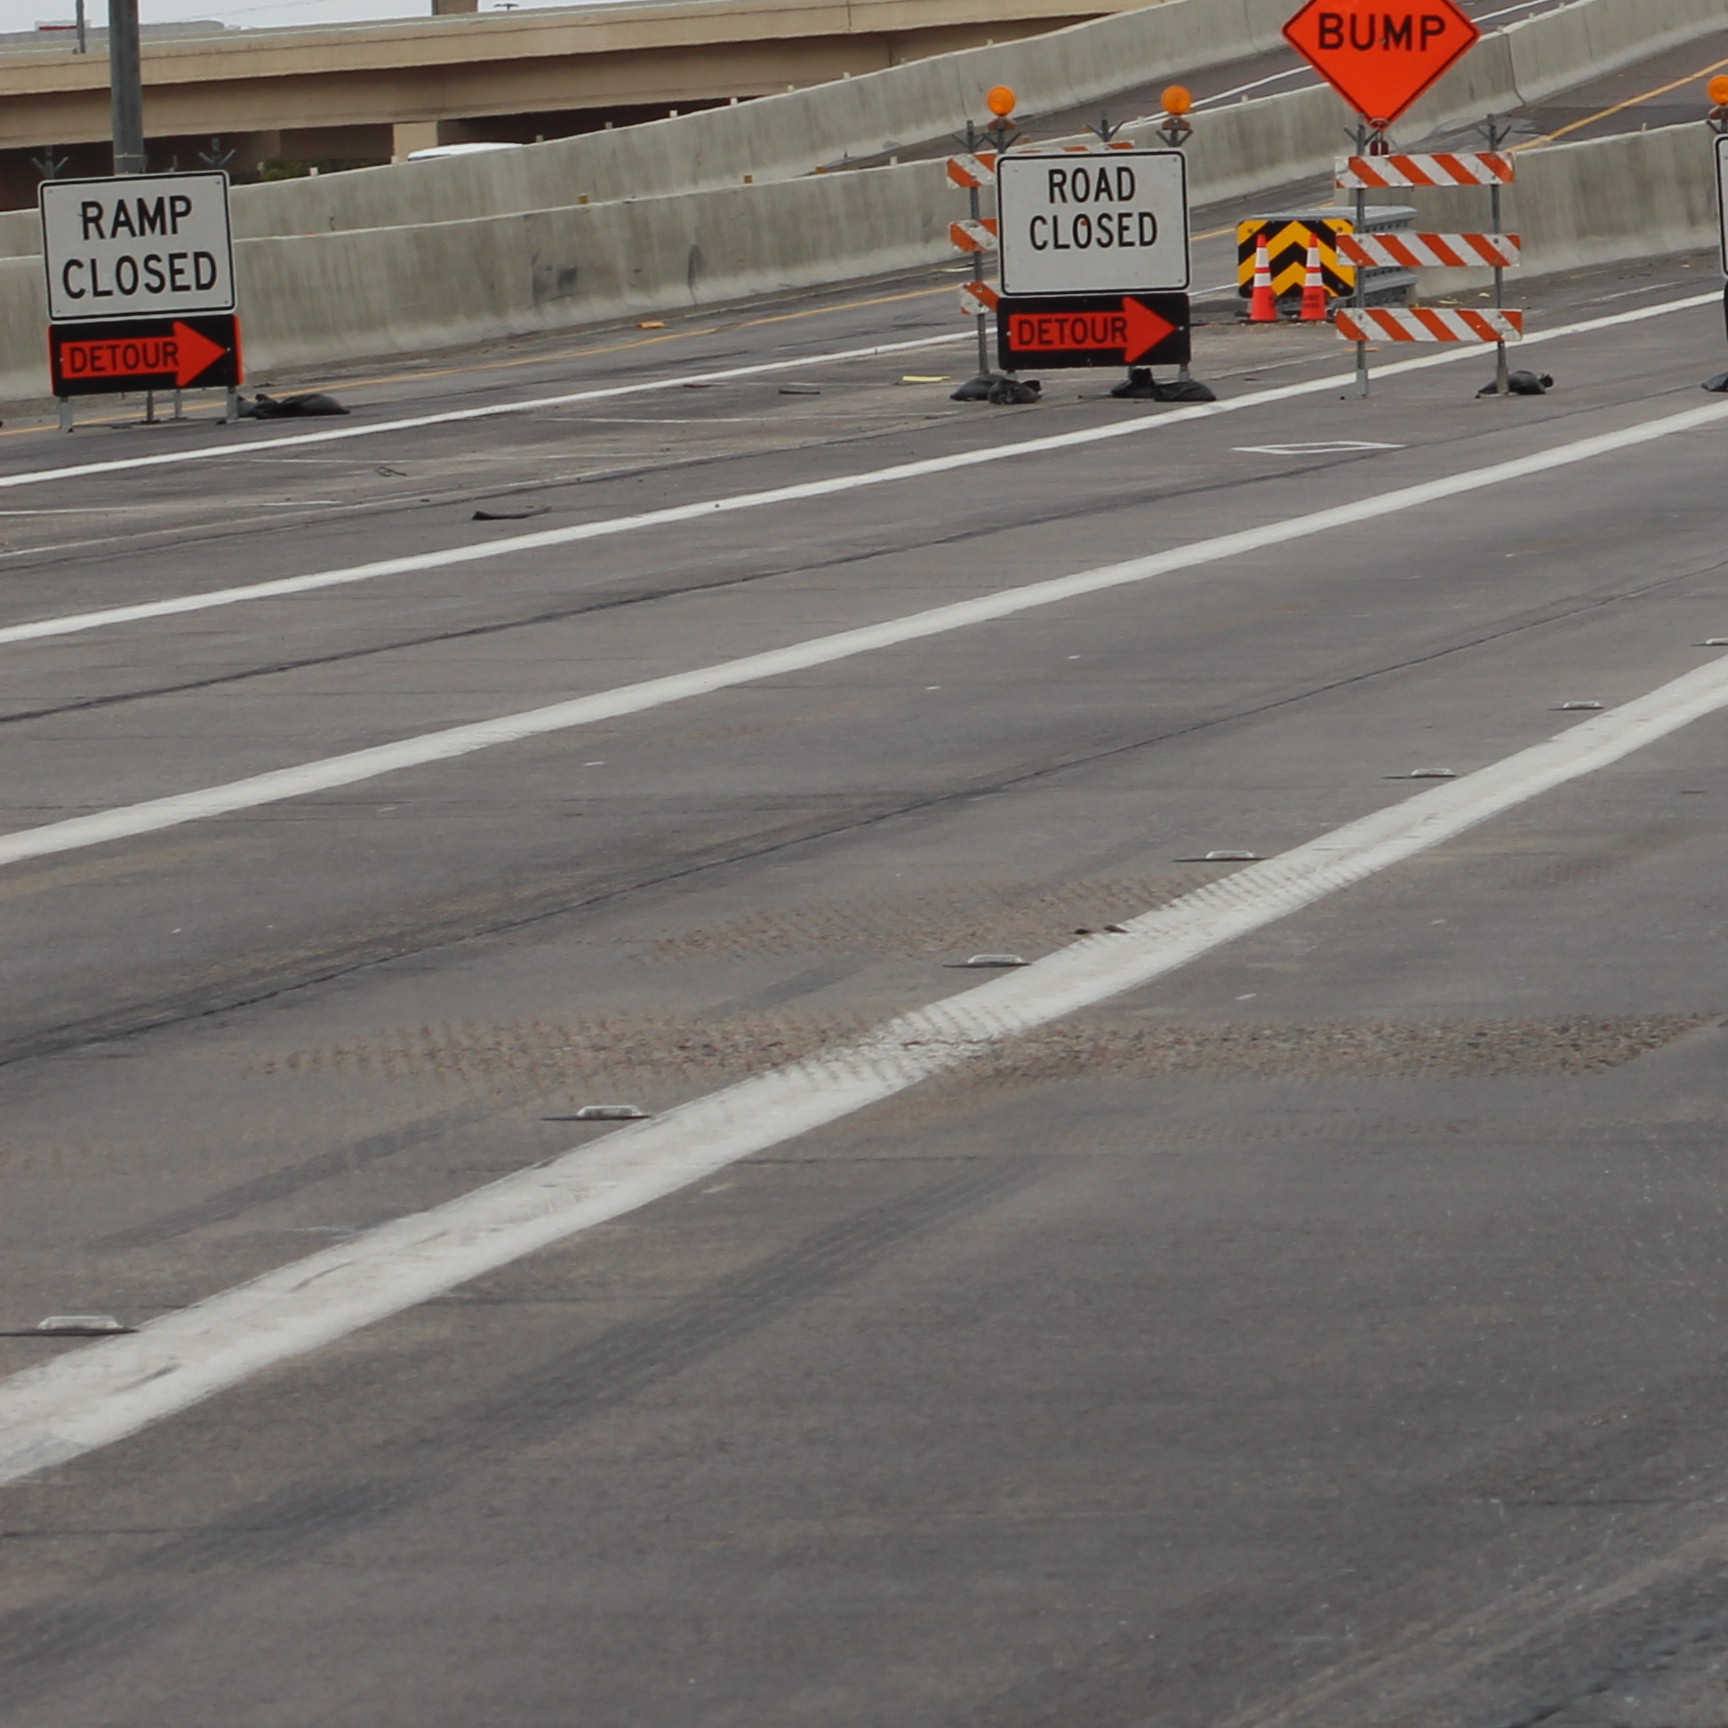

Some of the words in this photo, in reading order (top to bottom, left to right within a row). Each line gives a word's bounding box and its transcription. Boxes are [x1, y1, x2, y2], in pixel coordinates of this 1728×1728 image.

[1319, 12, 1445, 52] BUMP
[1048, 167, 1135, 203] ROAD
[81, 195, 192, 240] RAMP
[1030, 212, 1157, 250] CLOSED
[62, 251, 217, 299] CLOSED
[1018, 317, 1128, 345] DETOUR
[70, 342, 179, 372] DETOUR
